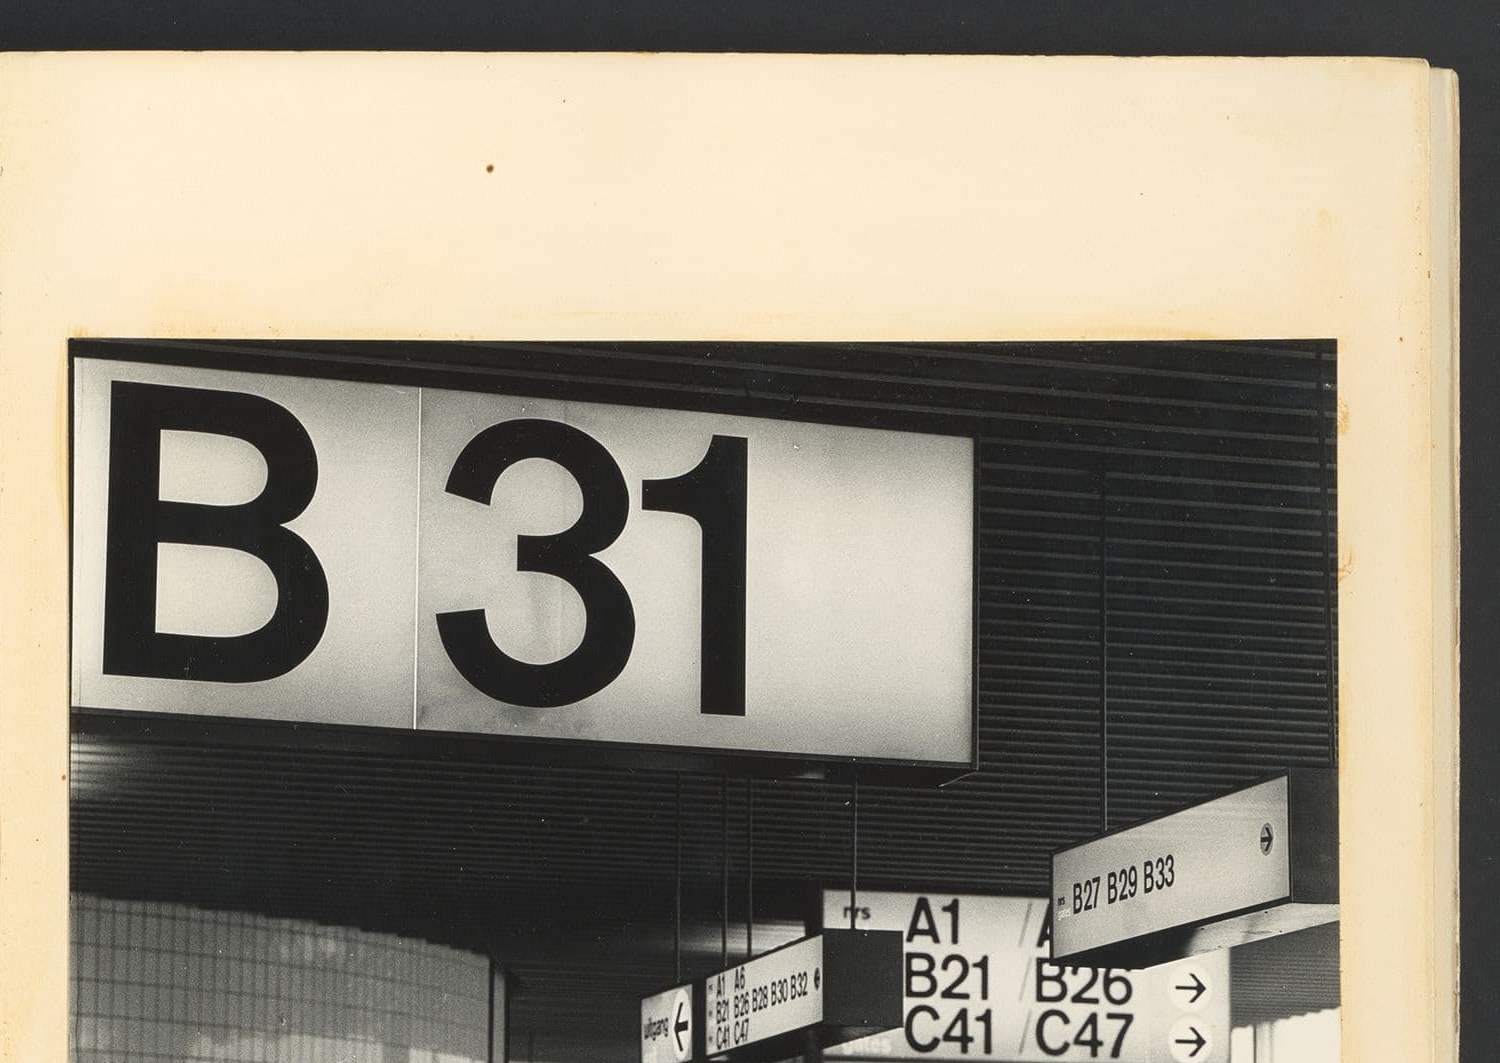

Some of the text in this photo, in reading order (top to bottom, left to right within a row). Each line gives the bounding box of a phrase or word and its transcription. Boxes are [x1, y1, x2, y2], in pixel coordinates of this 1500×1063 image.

[103, 380, 749, 717] B 31
[1073, 876, 1101, 914] B27
[1107, 865, 1138, 904] B29
[1143, 854, 1175, 894] B33
[905, 897, 959, 945] A1
[716, 966, 746, 997] A1 A6
[716, 971, 808, 1025] B21 B26 B28 B30 B32
[905, 951, 989, 1001] B21
[1036, 957, 1133, 1005] B26
[716, 1018, 749, 1050] C41 C47
[904, 1005, 992, 1055] C41
[1036, 1009, 1134, 1058] C47
